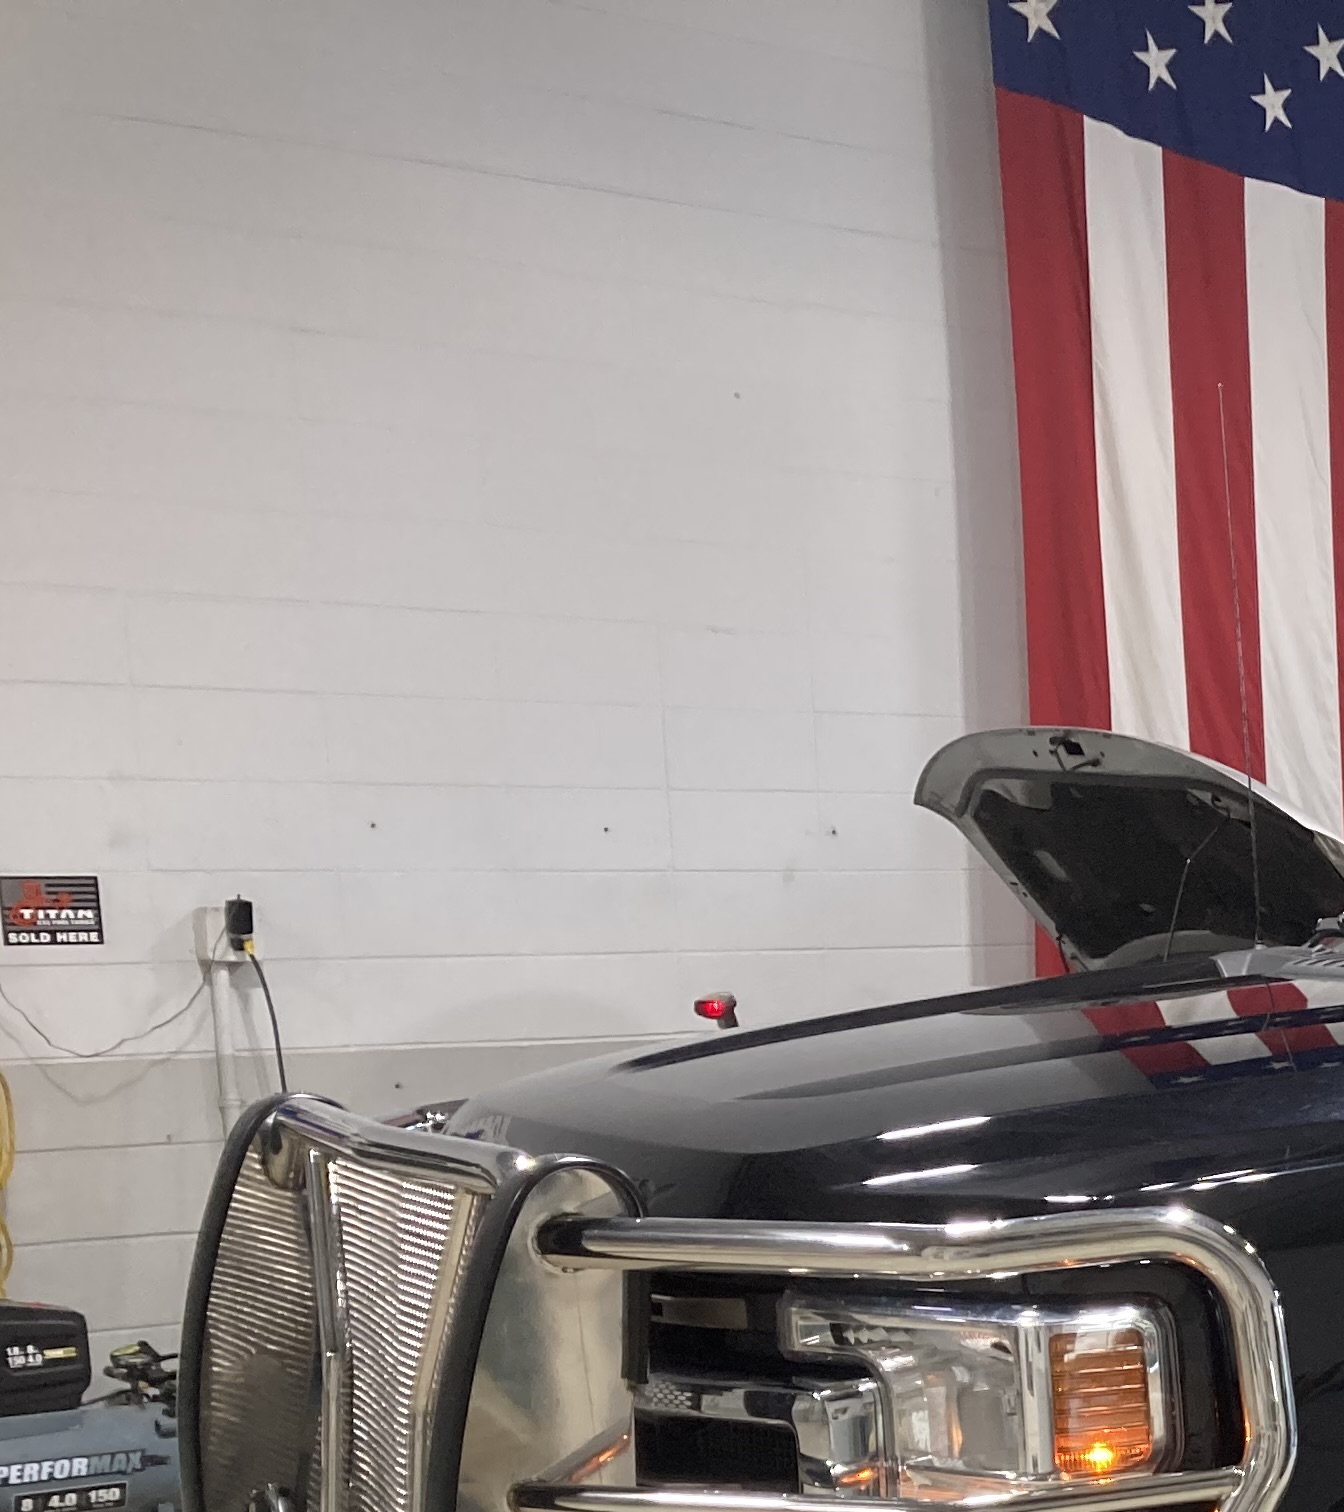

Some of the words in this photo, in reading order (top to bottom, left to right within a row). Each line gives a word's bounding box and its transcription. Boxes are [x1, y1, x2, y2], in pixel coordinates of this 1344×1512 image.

[19, 909, 94, 919] TITAN
[7, 932, 51, 943] SOLD
[56, 931, 100, 943] HERE
[0, 1451, 142, 1485] PERFORMAX
[21, 1498, 33, 1512] 8
[48, 1492, 77, 1508] 4.0
[88, 1487, 120, 1503] 150
